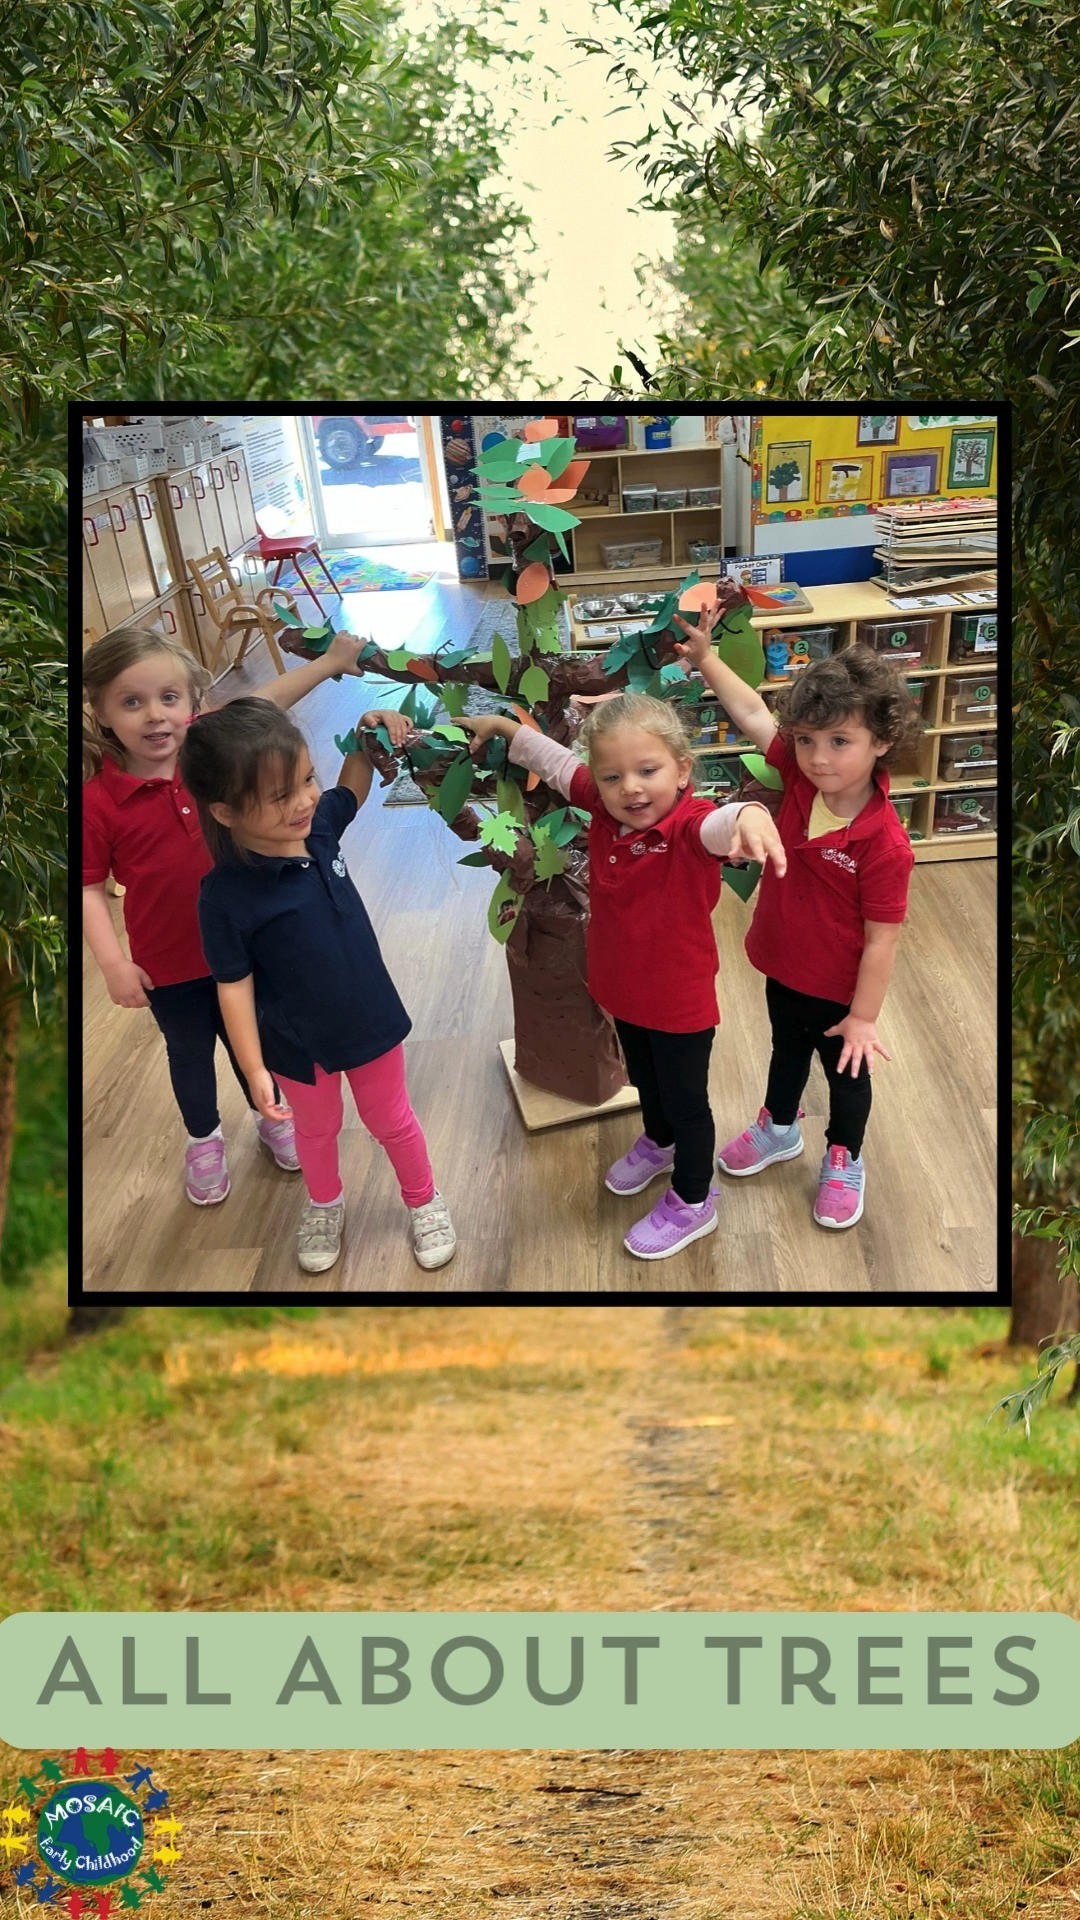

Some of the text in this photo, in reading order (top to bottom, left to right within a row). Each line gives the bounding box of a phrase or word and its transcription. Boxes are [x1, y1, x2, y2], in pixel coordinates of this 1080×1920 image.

[734, 560, 772, 570] Pocket Chart
[977, 688, 988, 697] 10
[969, 746, 980, 757] 15
[963, 801, 977, 810] 20
